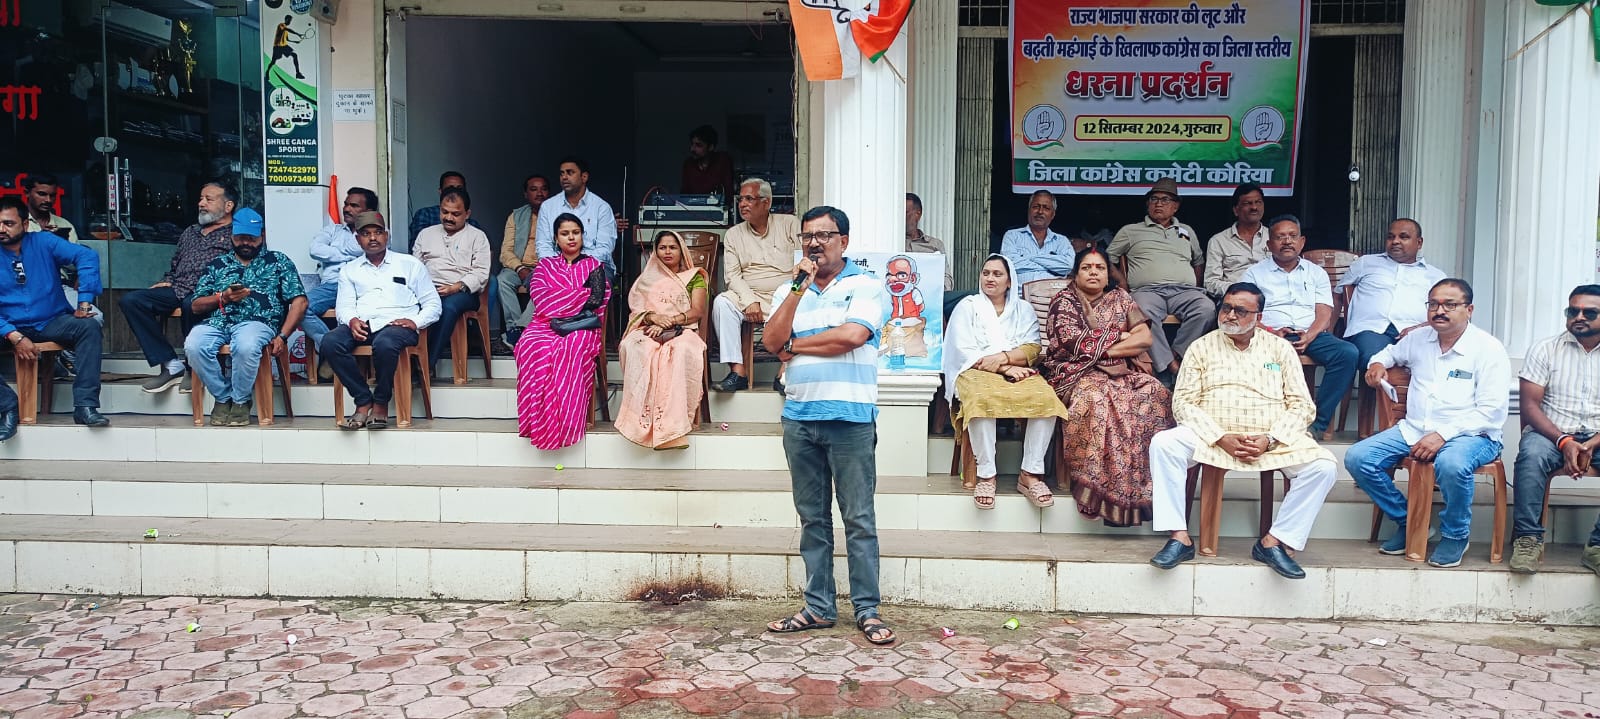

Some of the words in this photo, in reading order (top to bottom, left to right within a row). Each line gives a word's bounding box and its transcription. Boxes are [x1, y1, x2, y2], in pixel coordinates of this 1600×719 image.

[1069, 8, 1097, 25] राज्य
[1098, 8, 1138, 25] भाजपा
[1139, 8, 1180, 25] सरकार
[1181, 3, 1200, 25] की
[1201, 8, 1221, 29] लूट
[1223, 3, 1247, 25] और
[1023, 35, 1055, 61] बढ़ती
[1057, 35, 1098, 60] महंगाई
[1099, 36, 1114, 57] के
[1115, 35, 1161, 58] खिलाफ
[1162, 36, 1201, 58] कांग्रेस
[1202, 41, 1222, 58] का
[1222, 35, 1254, 58] जिला
[1255, 35, 1293, 58] स्तरीय
[1065, 70, 1137, 98] धरना
[1139, 60, 1233, 100] प्रदर्शन
[1082, 122, 1096, 135] 12
[1099, 119, 1144, 135] सितम्बर
[1027, 160, 1078, 182] जिला
[1079, 161, 1143, 183] कांग्रेस
[1144, 161, 1204, 183] कमेटी
[1206, 161, 1275, 184] कोरिया
